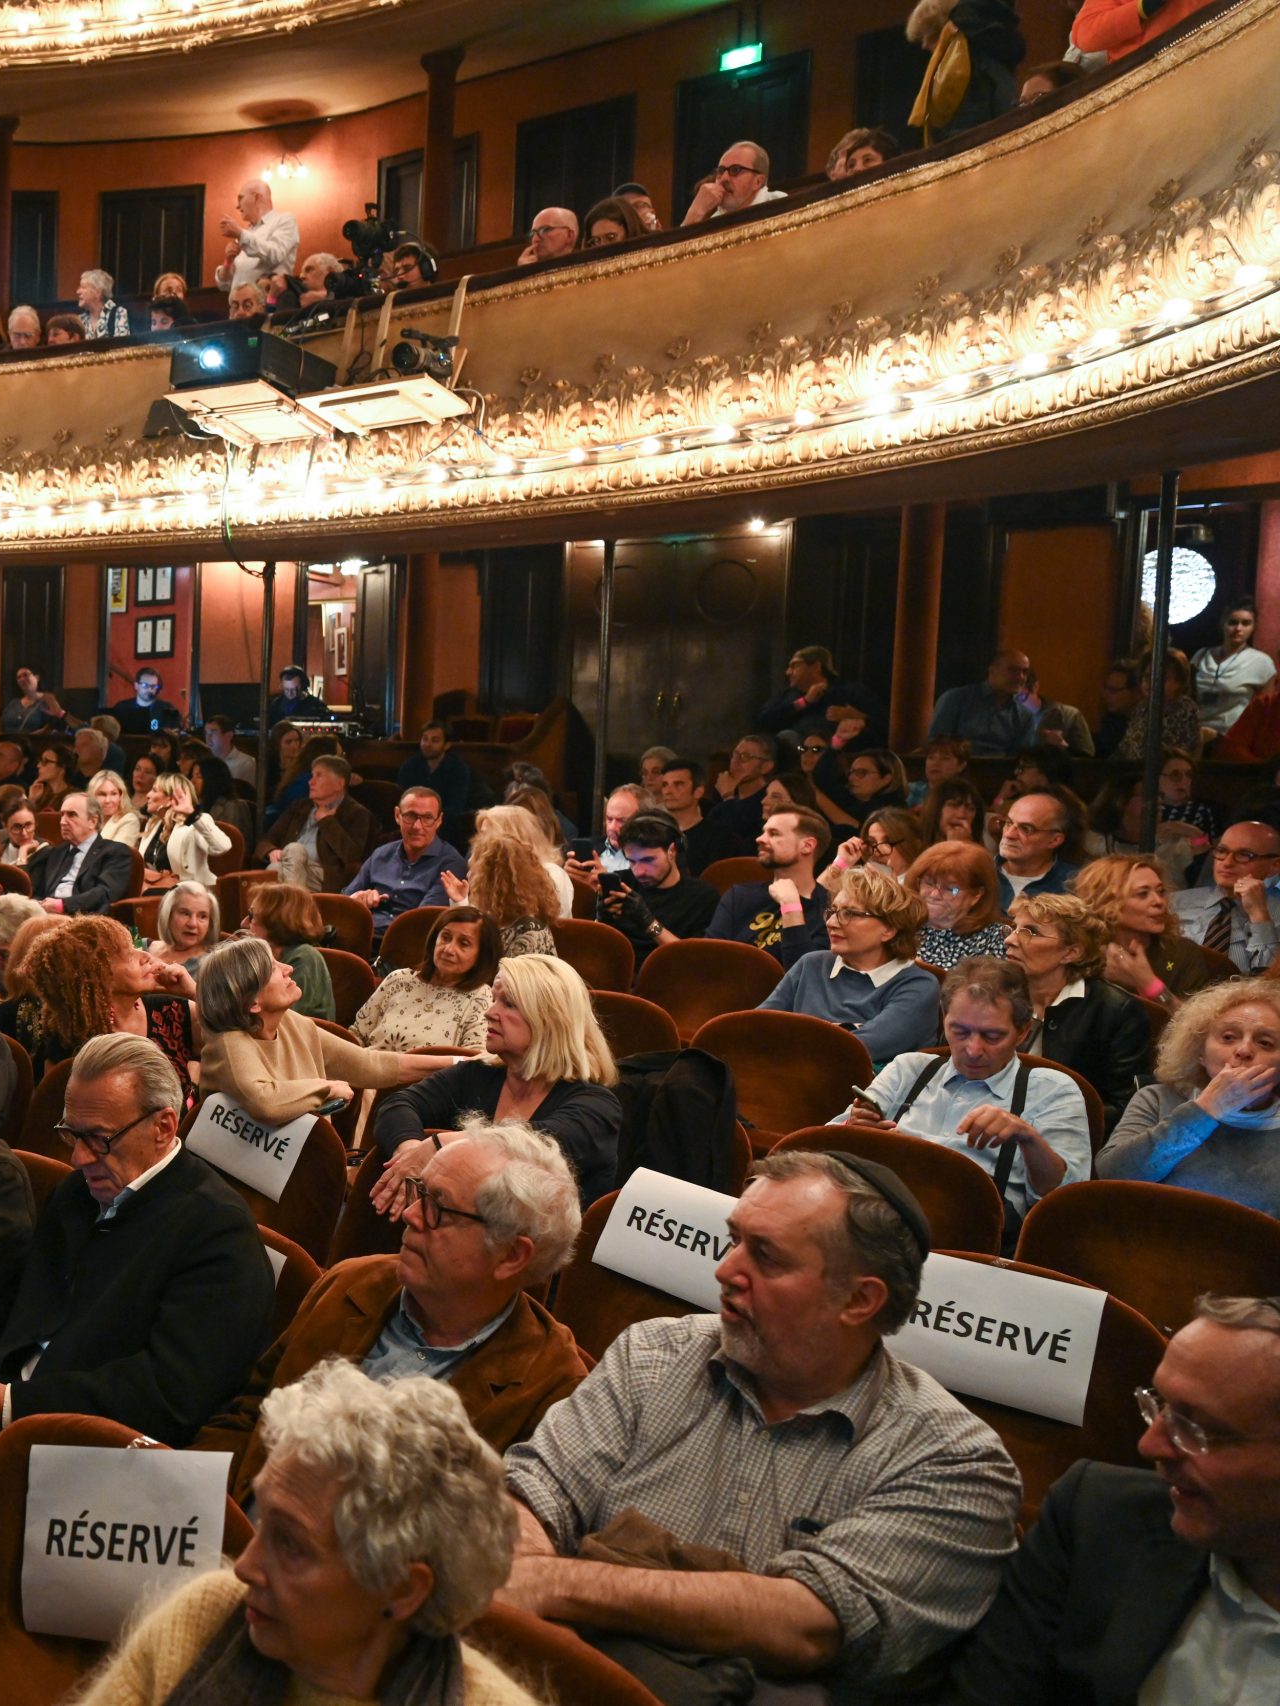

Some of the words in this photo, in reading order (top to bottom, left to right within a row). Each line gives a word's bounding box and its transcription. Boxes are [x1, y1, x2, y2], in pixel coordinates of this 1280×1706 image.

[210, 1104, 291, 1160] RÉSERVÉ
[626, 1205, 732, 1261] RÉSERV
[909, 1300, 1072, 1364] RÉSERVÉ
[45, 1510, 199, 1567] RÉSERVÉ
